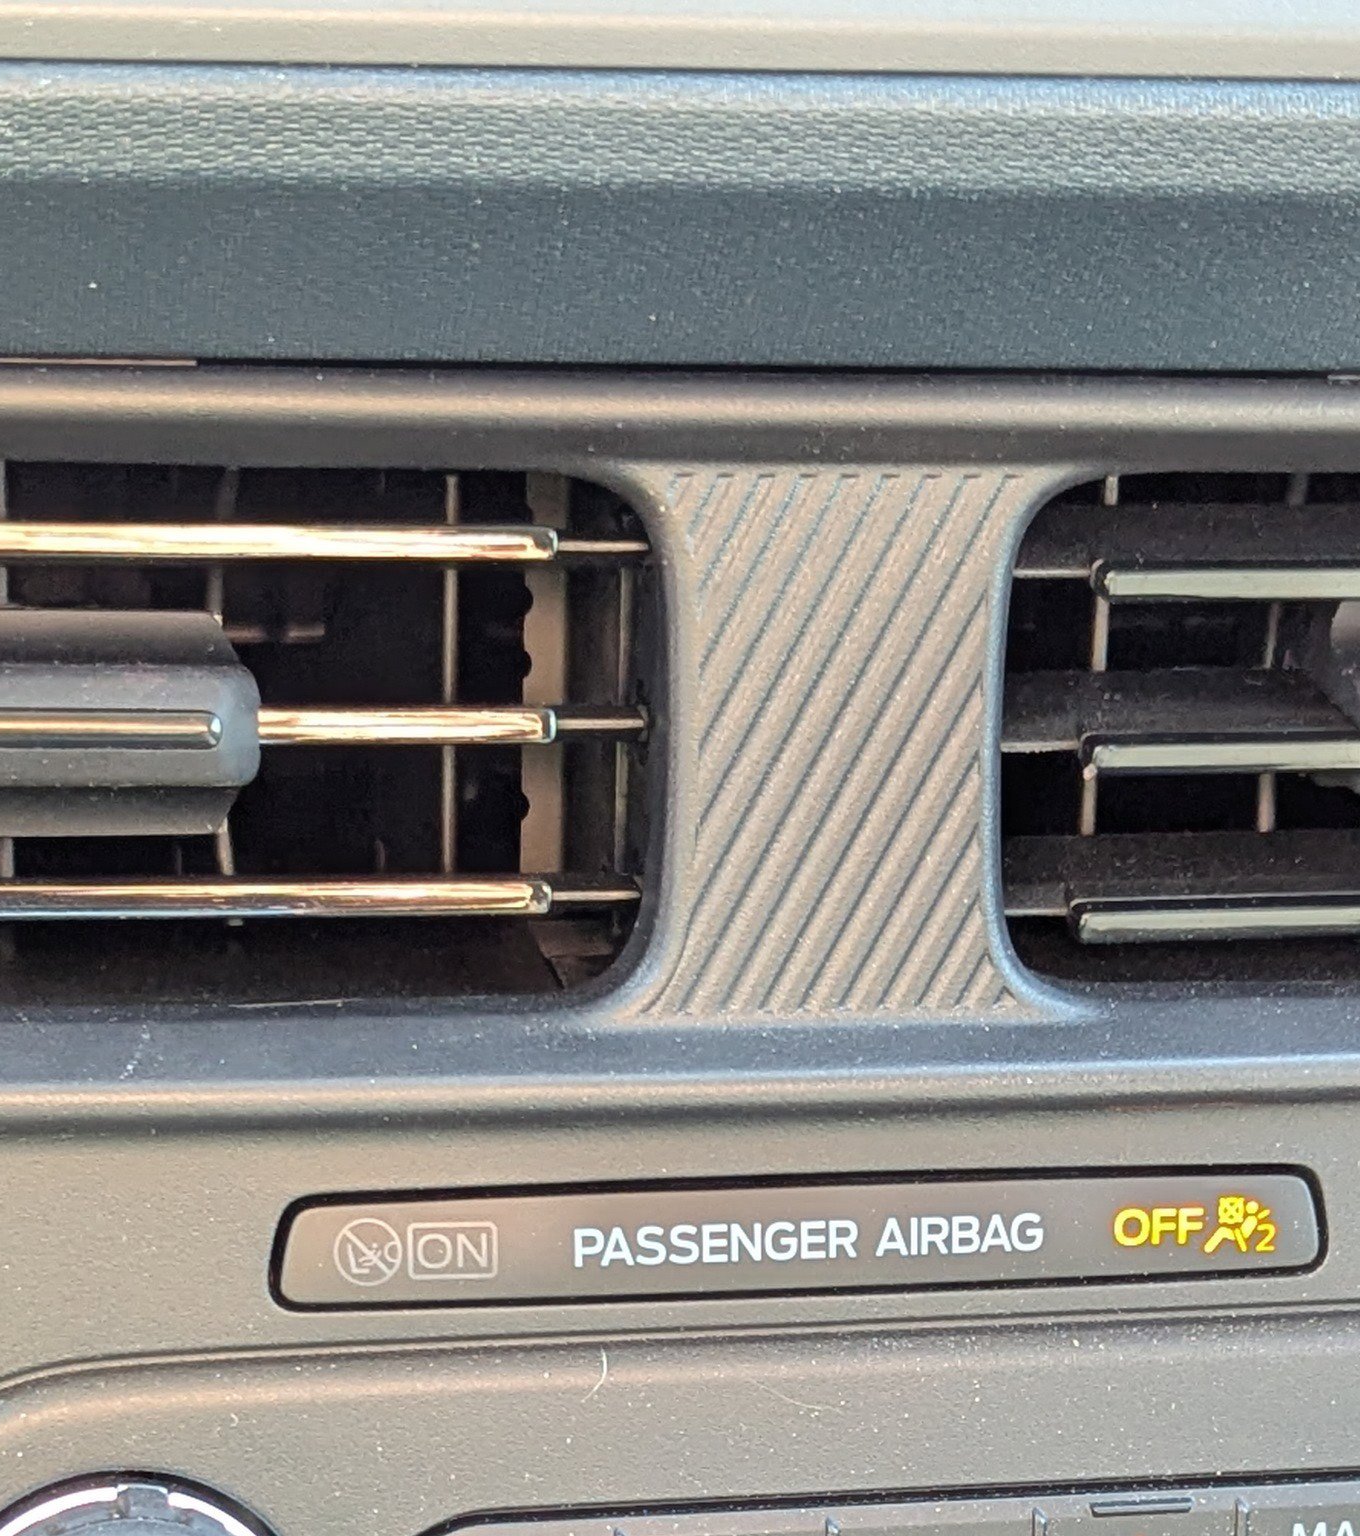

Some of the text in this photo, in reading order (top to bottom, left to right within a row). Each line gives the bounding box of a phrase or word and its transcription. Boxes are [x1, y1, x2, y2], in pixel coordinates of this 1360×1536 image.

[573, 1212, 1044, 1268] PASSENGER AIRBAG
[1113, 1206, 1205, 1247] OFF
[1255, 1223, 1277, 1252] 2
[416, 1232, 488, 1269] ON
